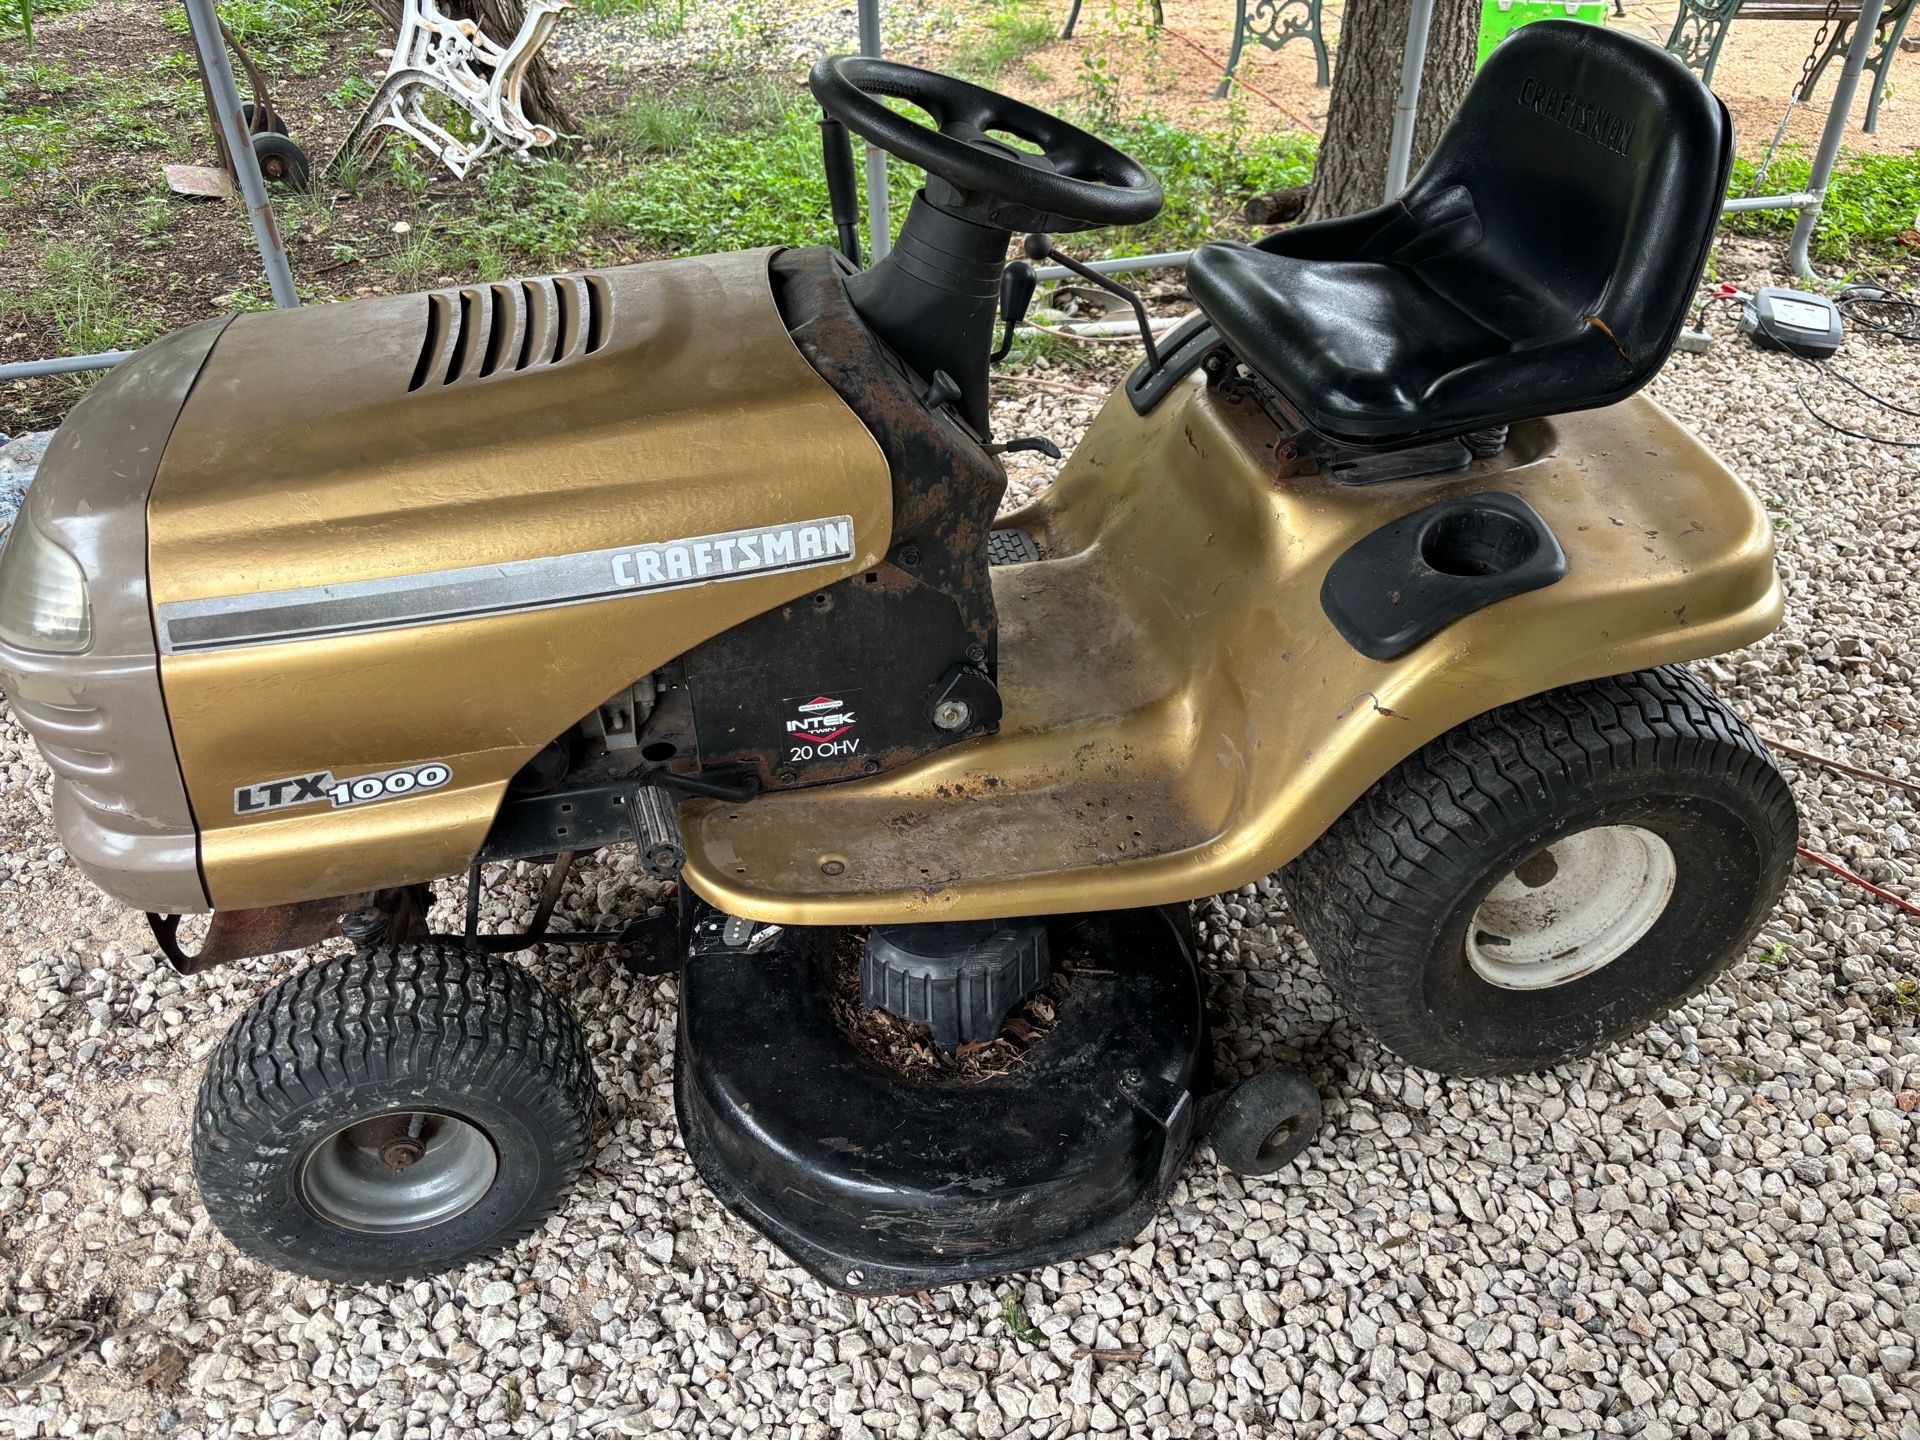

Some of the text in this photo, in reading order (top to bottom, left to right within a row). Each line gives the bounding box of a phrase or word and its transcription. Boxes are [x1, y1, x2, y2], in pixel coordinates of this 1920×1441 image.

[1518, 76, 1635, 157] CRAFTSMAN
[611, 521, 850, 587] CRAFTSMAN
[786, 711, 857, 732] INTEK
[807, 726, 837, 735] TWIN
[790, 738, 860, 761] 20 OHV
[238, 765, 450, 812] LTX 1000
